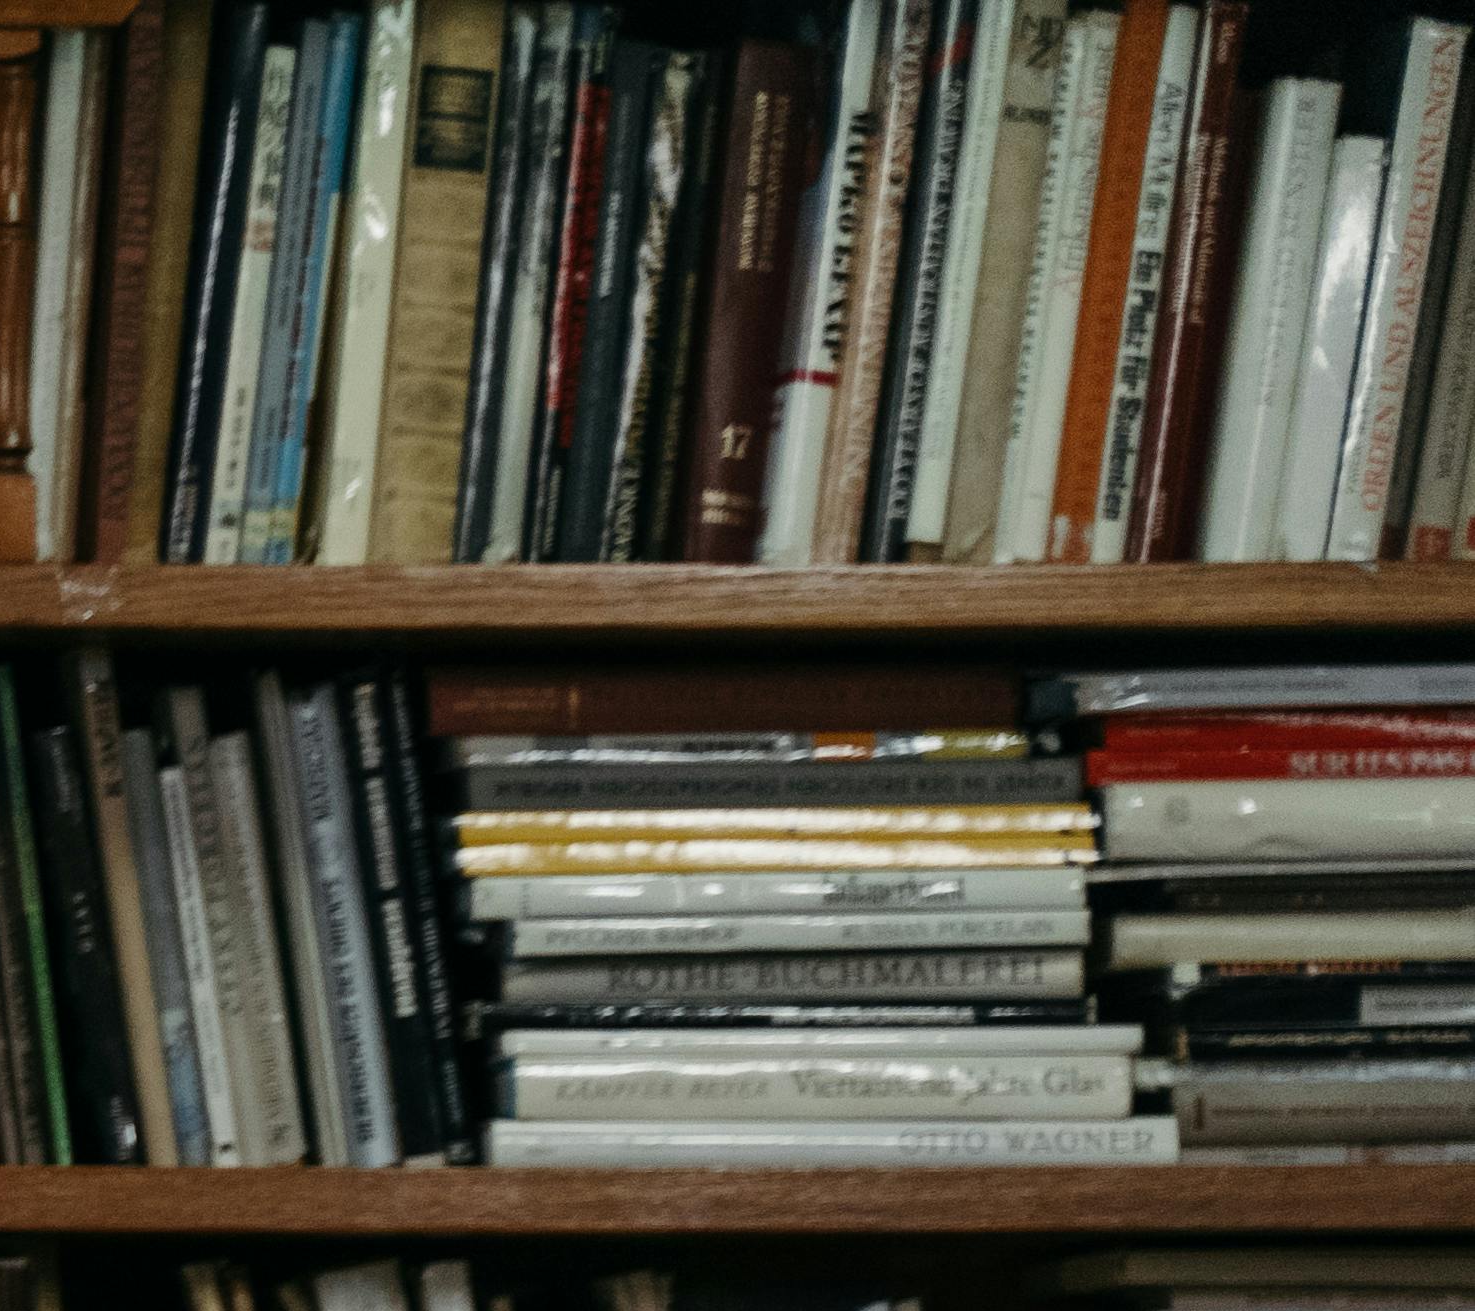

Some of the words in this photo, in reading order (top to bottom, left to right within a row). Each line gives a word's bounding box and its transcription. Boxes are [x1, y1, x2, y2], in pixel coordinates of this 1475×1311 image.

[1382, 31, 1463, 317] AUSZEICHNUNGEN
[1377, 319, 1413, 393] UND
[1357, 394, 1401, 512] ORDEN
[754, 958, 1045, 990] BUCHMALEREI
[1001, 1127, 1155, 1156] WAGNER
